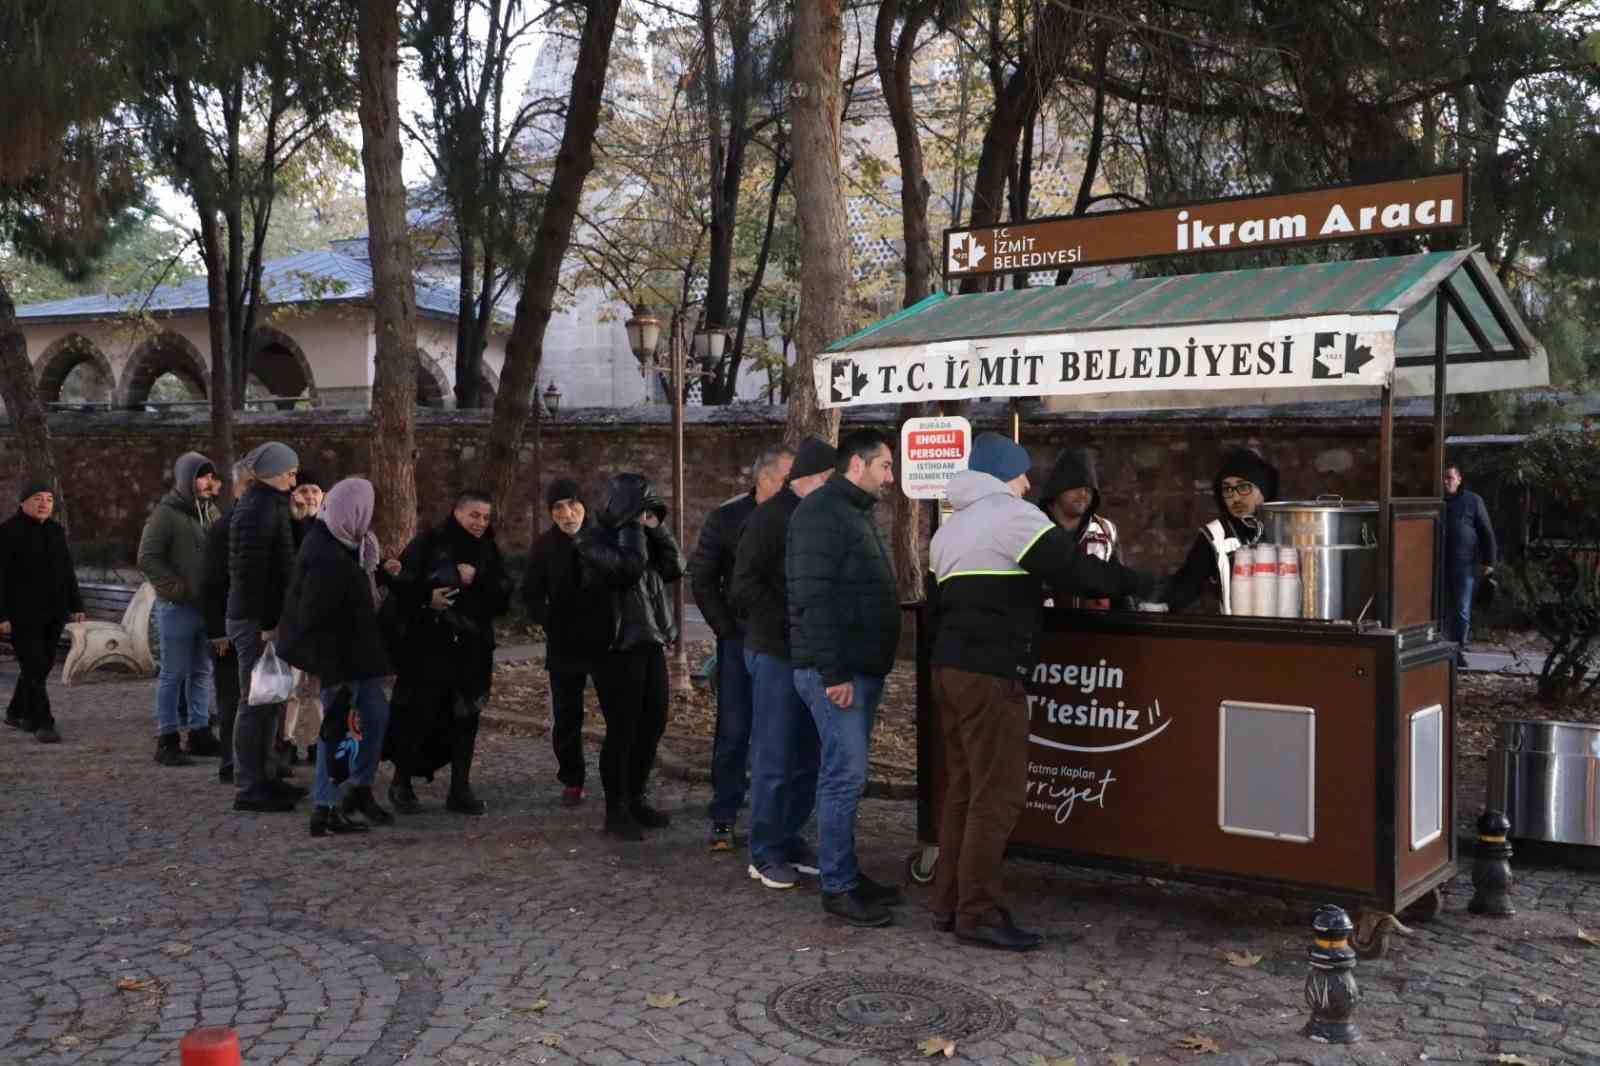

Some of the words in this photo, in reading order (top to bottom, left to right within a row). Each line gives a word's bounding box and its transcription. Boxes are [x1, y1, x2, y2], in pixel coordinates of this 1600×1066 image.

[1319, 199, 1454, 235] Aracı
[878, 362, 934, 394] T.C.
[1059, 335, 1295, 383] BELEDİYESİ
[910, 448, 961, 458] PERSONEL
[1026, 694, 1140, 731] T'tesiniz
[1028, 761, 1058, 776] Fatma
[1061, 765, 1096, 780] Kaplan
[1025, 769, 1117, 825] rriyet
